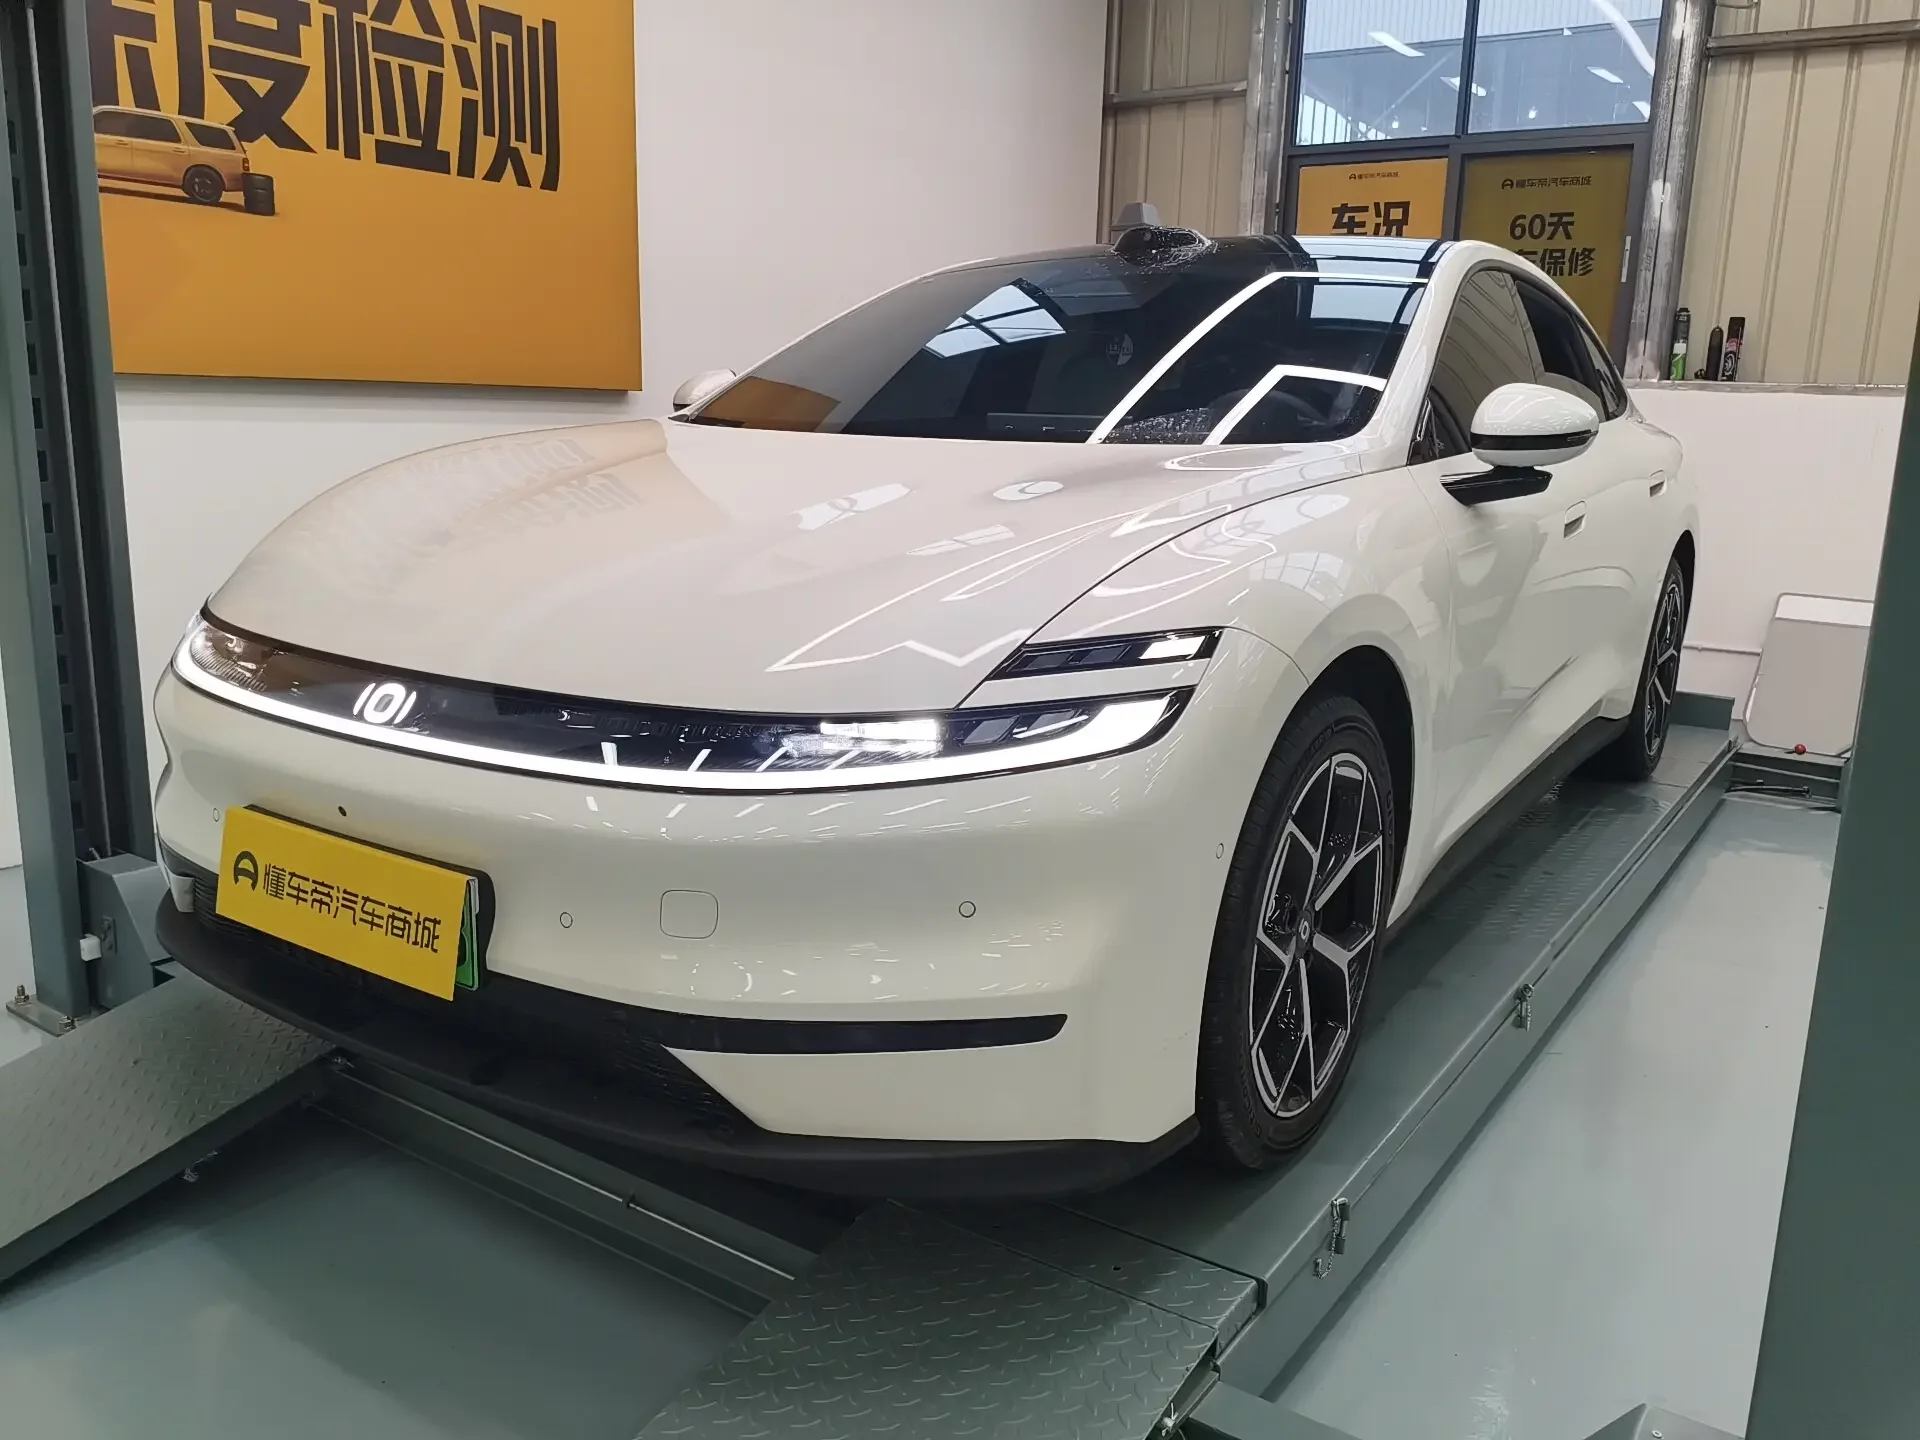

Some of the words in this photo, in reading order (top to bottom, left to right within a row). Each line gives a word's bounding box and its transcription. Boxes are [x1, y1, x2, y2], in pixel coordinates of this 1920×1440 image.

[1331, 201, 1411, 236] 车况
[1509, 212, 1575, 241] 60天
[263, 863, 442, 954] 懂车帝汽车商城
